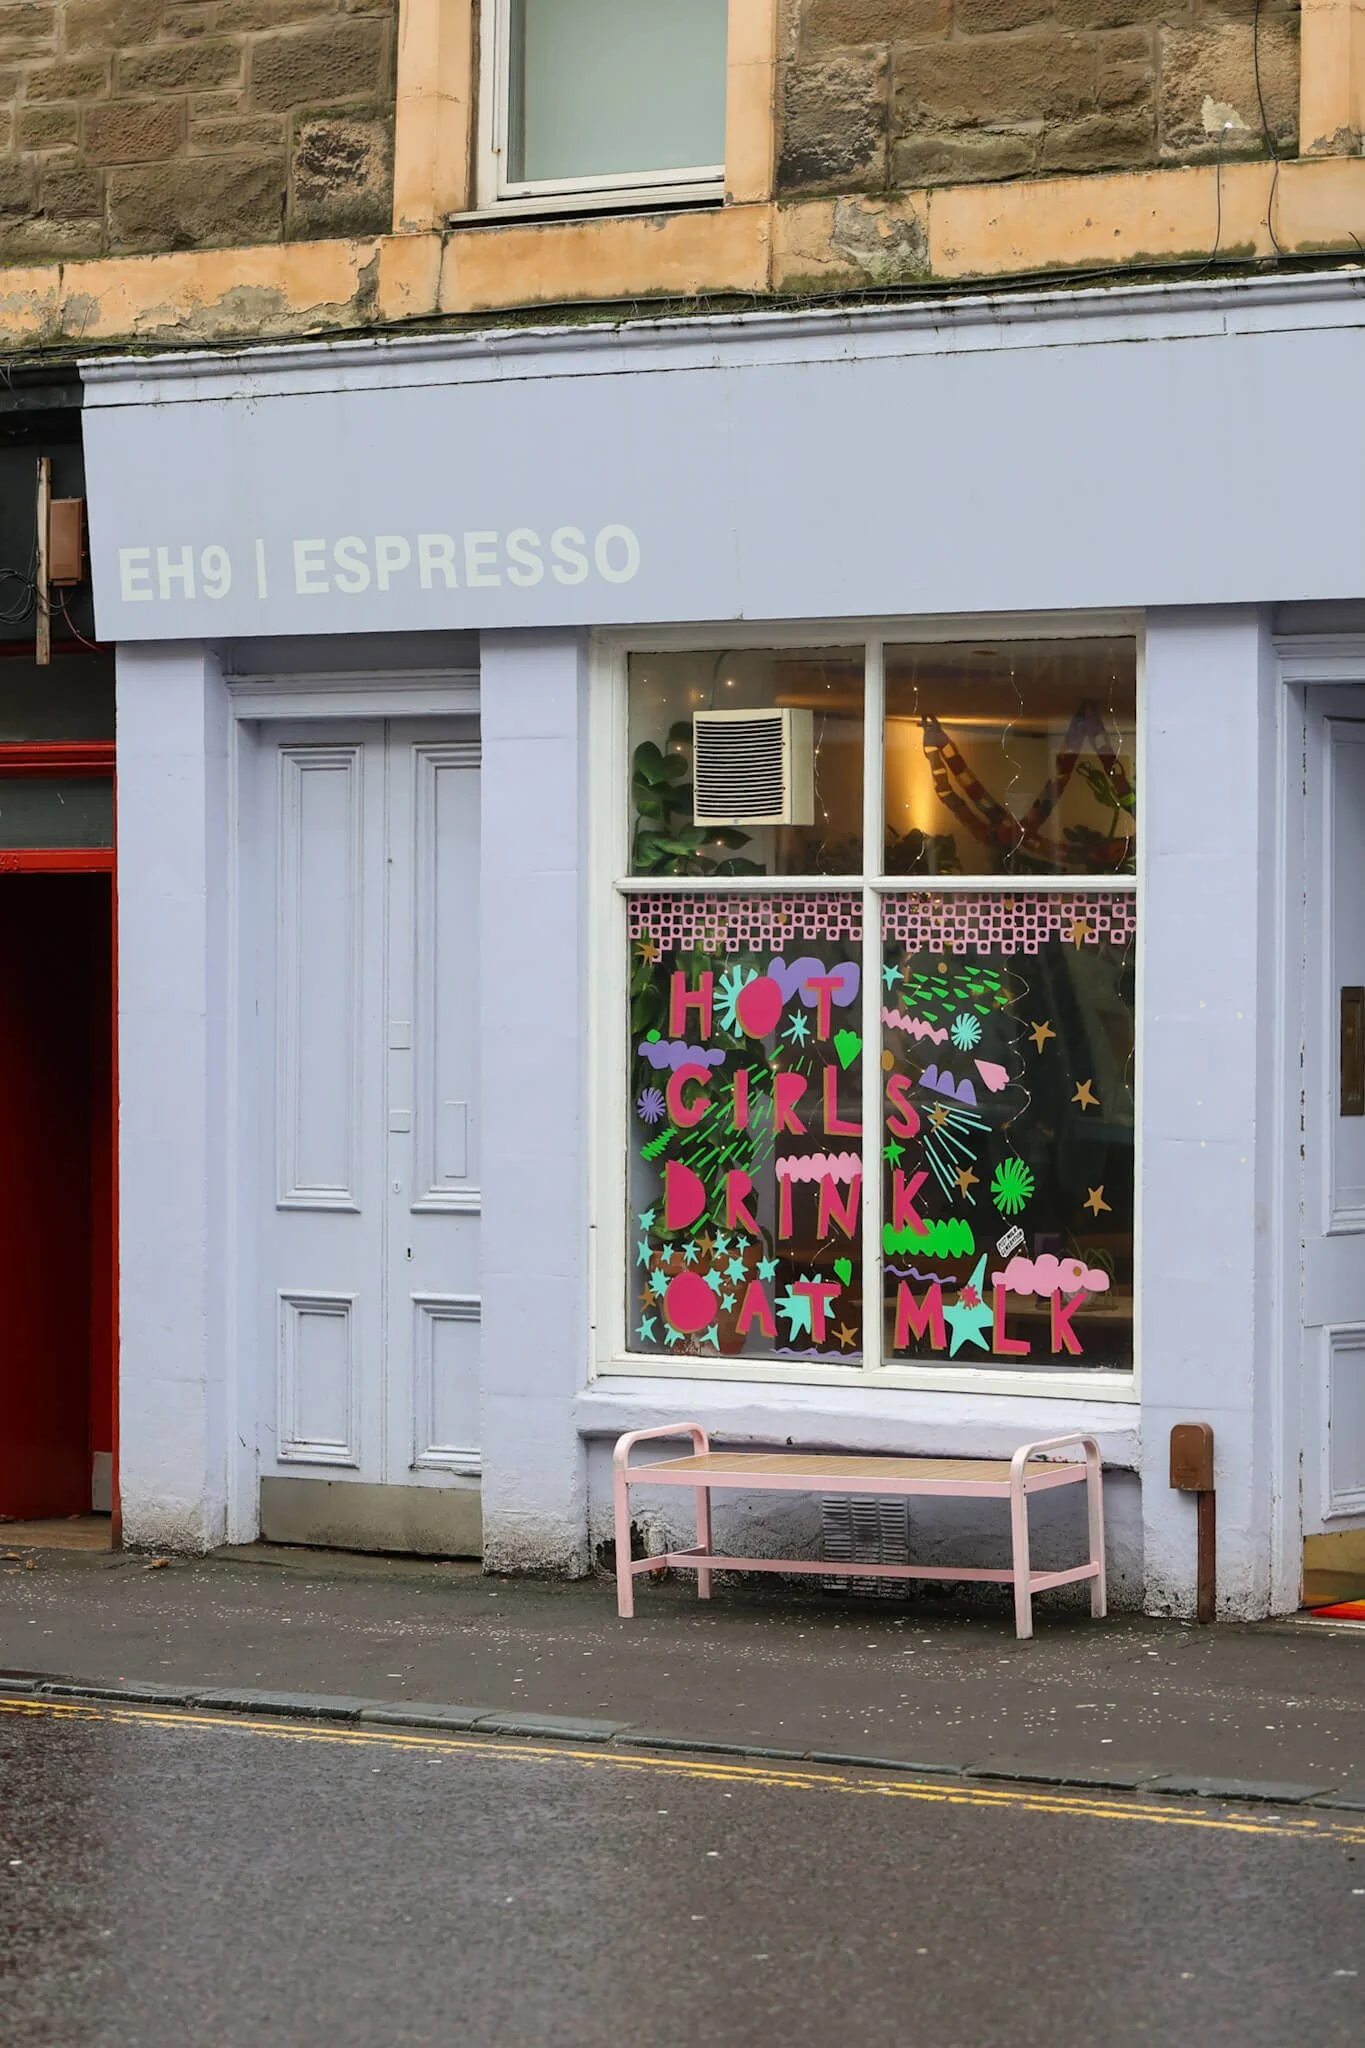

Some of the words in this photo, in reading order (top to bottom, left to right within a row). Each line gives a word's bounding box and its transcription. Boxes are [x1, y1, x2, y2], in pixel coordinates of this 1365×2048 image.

[119, 545, 232, 601] EH9
[293, 524, 641, 595] ESPRESSO
[669, 971, 844, 1040] HOT
[667, 1062, 920, 1137] GIRLS
[665, 1160, 929, 1240] DRINK
[664, 1271, 842, 1343] OAT
[893, 1279, 1087, 1355] MLK
